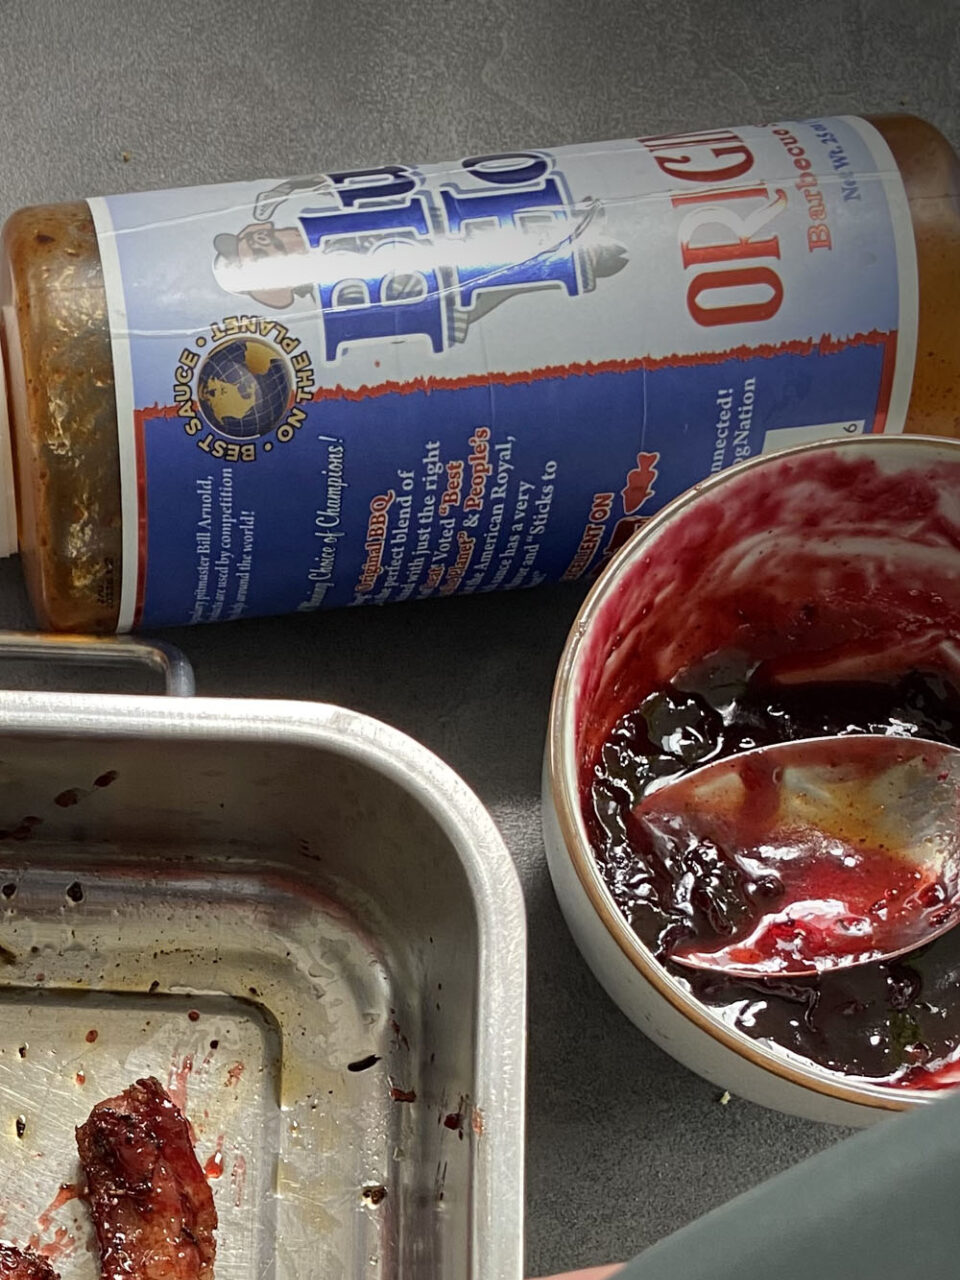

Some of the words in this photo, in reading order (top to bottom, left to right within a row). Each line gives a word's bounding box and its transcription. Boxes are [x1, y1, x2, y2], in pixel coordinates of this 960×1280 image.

[829, 144, 851, 171] Wt.
[773, 128, 833, 253] Barbecue
[210, 314, 301, 354] PLANET
[173, 347, 202, 436] SAUCE
[291, 351, 315, 402] THE
[277, 408, 308, 442] ON
[197, 434, 256, 463] BEST
[421, 440, 444, 491] right
[315, 436, 348, 528] Champions!
[397, 469, 415, 491] of
[196, 475, 213, 530] Arnold,
[219, 468, 237, 549] competition
[367, 489, 397, 542] BBQ
[390, 495, 413, 545] blend
[417, 495, 436, 525] the
[463, 513, 481, 528] &
[474, 503, 505, 572] American
[490, 436, 517, 500] Royal,
[513, 480, 536, 521] very
[523, 543, 541, 568] and
[541, 460, 558, 482] to
[590, 492, 616, 523] ON
[196, 532, 211, 554] Bill
[239, 511, 255, 552] world!
[314, 532, 345, 545] of
[412, 527, 432, 555] just
[431, 517, 456, 564] Voted
[499, 534, 522, 557] has
[511, 523, 524, 533] a
[214, 566, 229, 588] used
[220, 551, 234, 568] by
[236, 554, 252, 571] the
[307, 546, 336, 581] Choice
[355, 542, 385, 592] Original
[384, 548, 405, 588] perfect
